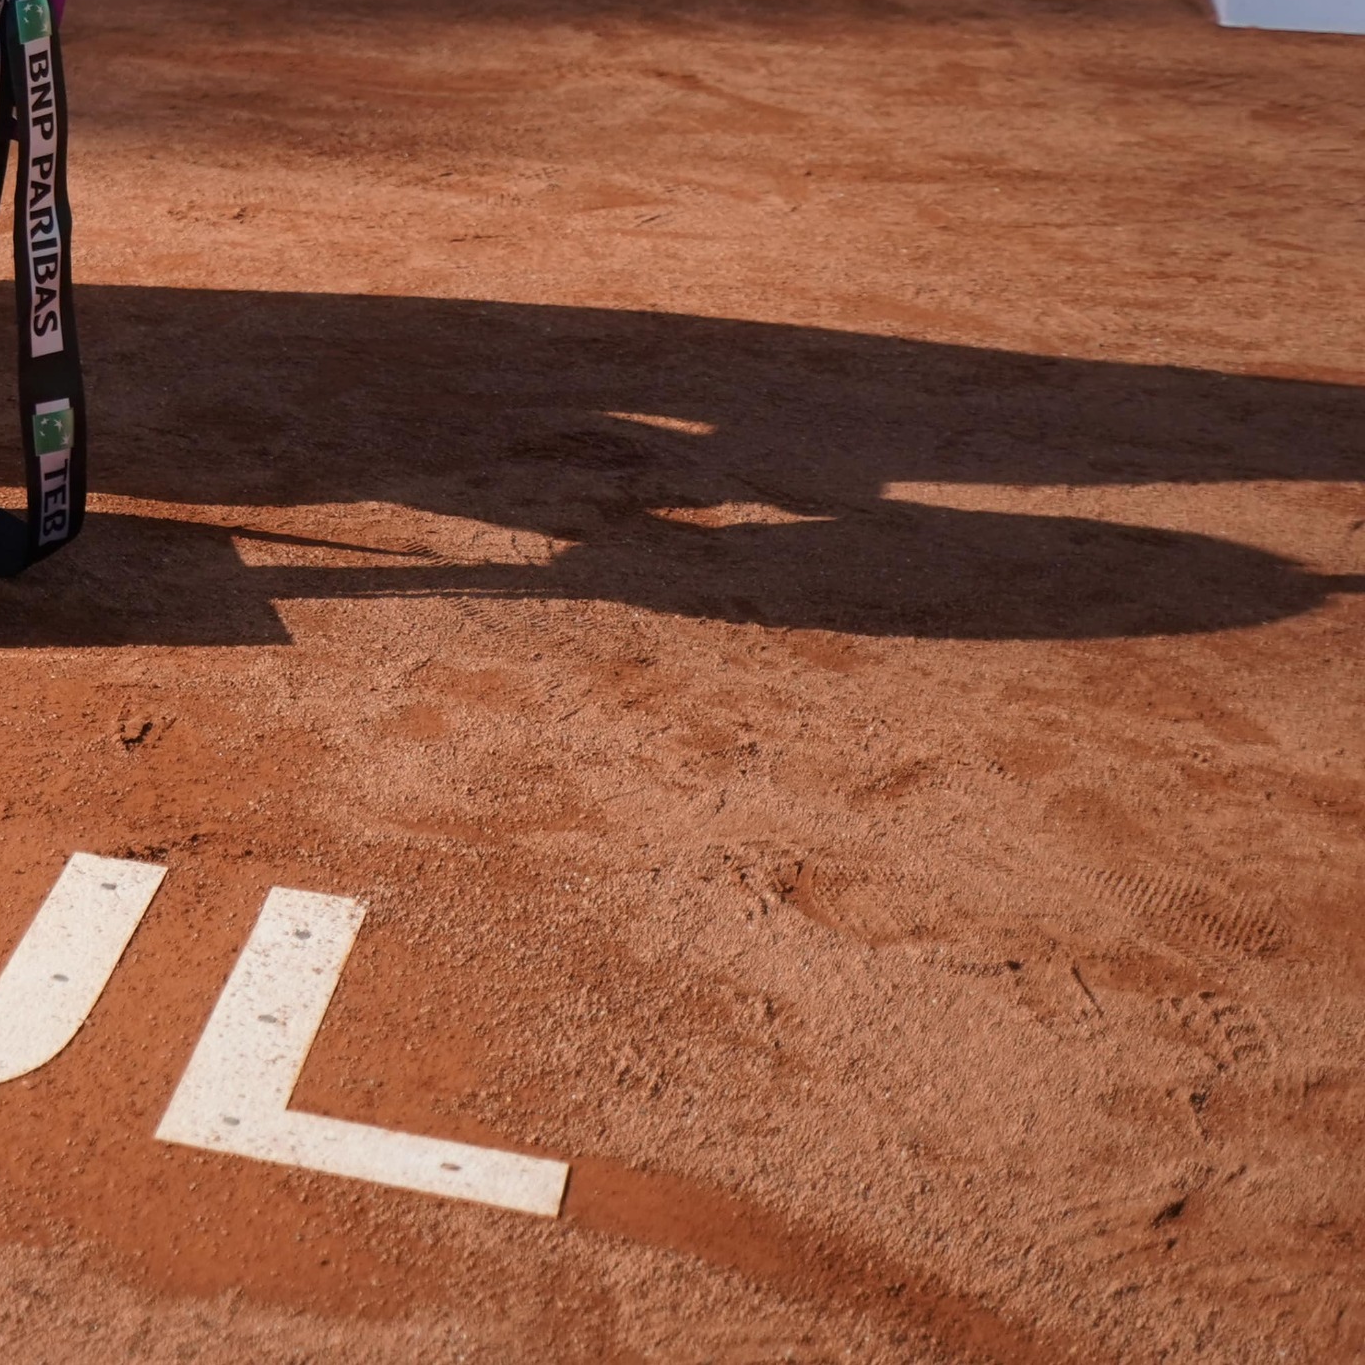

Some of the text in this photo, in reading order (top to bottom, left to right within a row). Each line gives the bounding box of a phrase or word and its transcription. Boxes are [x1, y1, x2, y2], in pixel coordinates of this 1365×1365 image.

[27, 49, 60, 338] BNP PARIBAS
[42, 458, 69, 537] TEB
